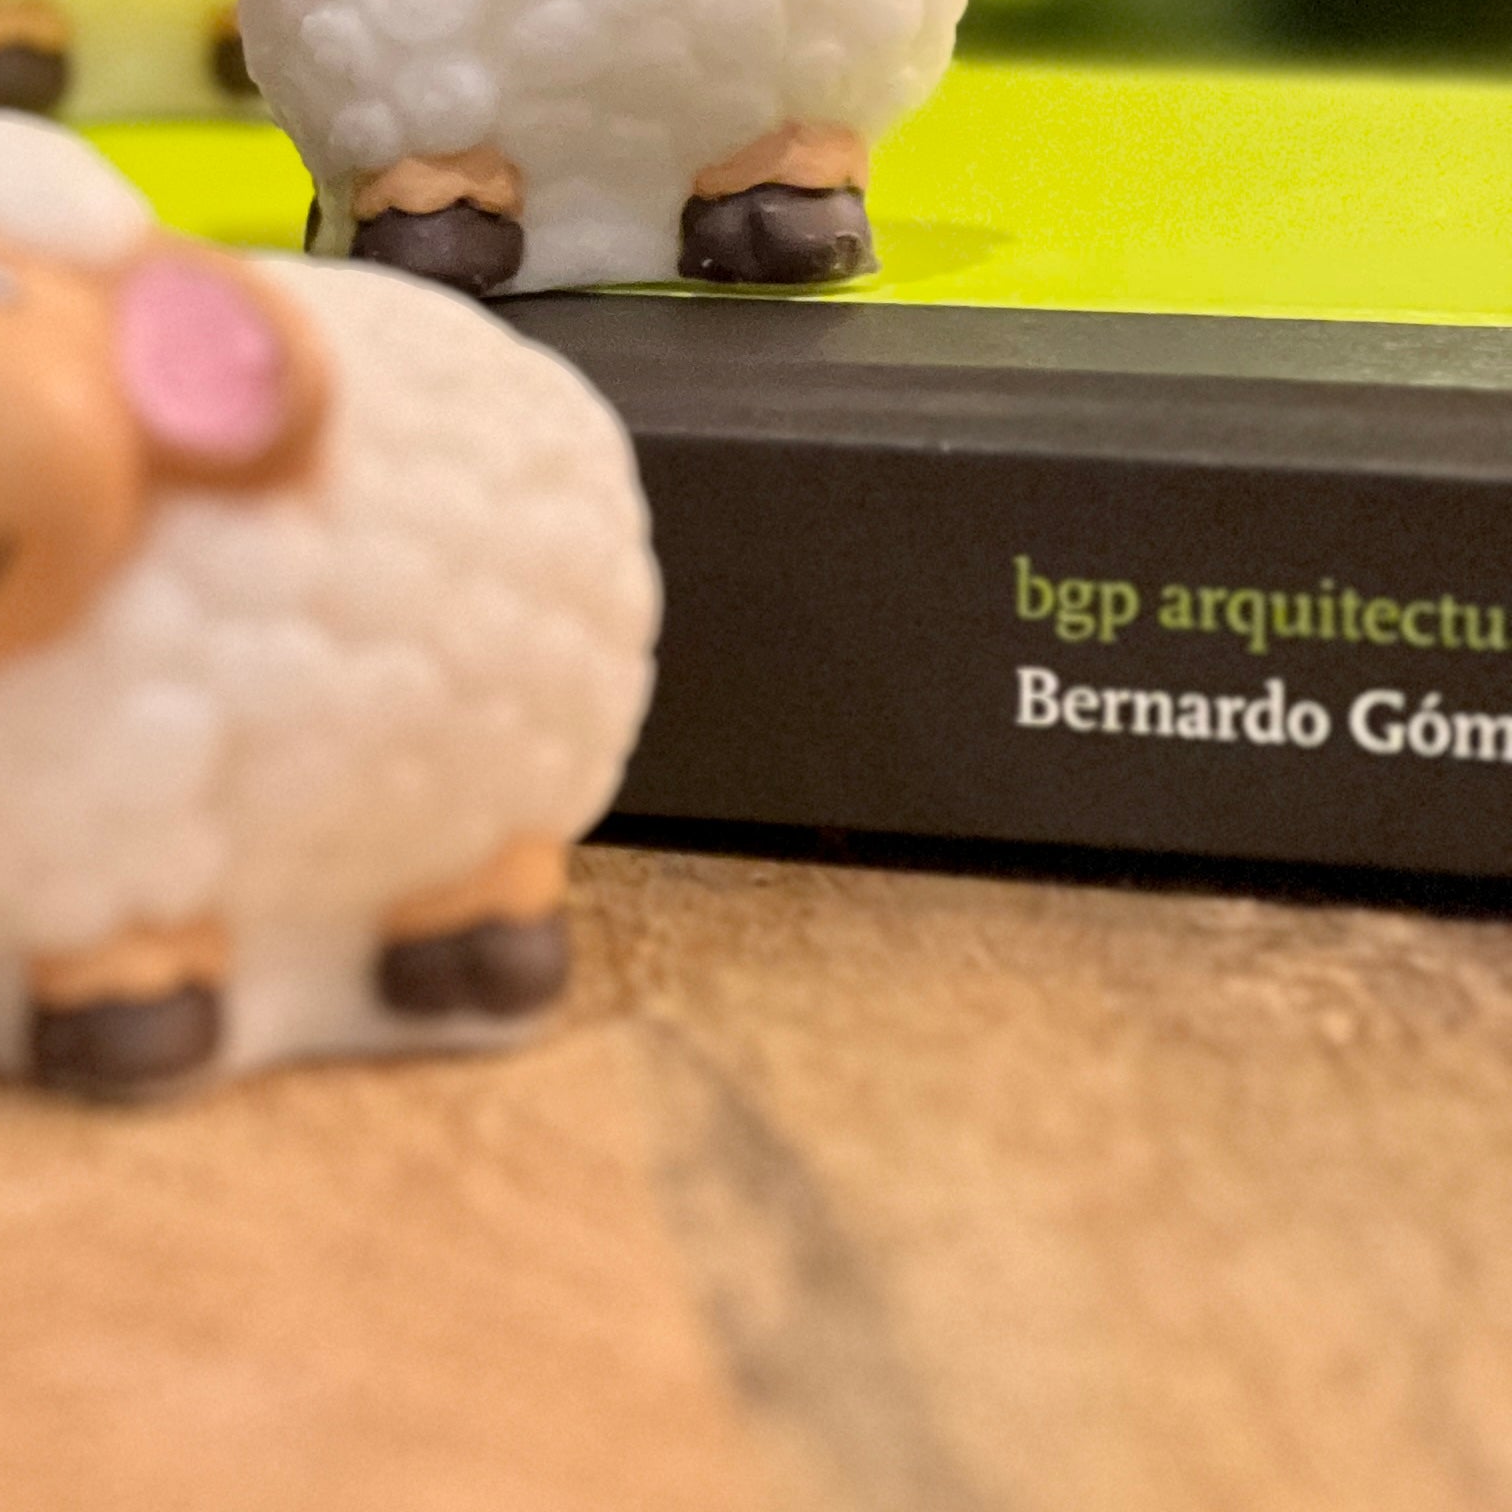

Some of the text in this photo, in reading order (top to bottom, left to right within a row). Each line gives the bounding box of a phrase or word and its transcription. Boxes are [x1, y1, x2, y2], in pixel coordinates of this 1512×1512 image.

[1014, 555, 1510, 655] bgp arquitectu
[1015, 665, 1512, 763] Bernardo Góm
